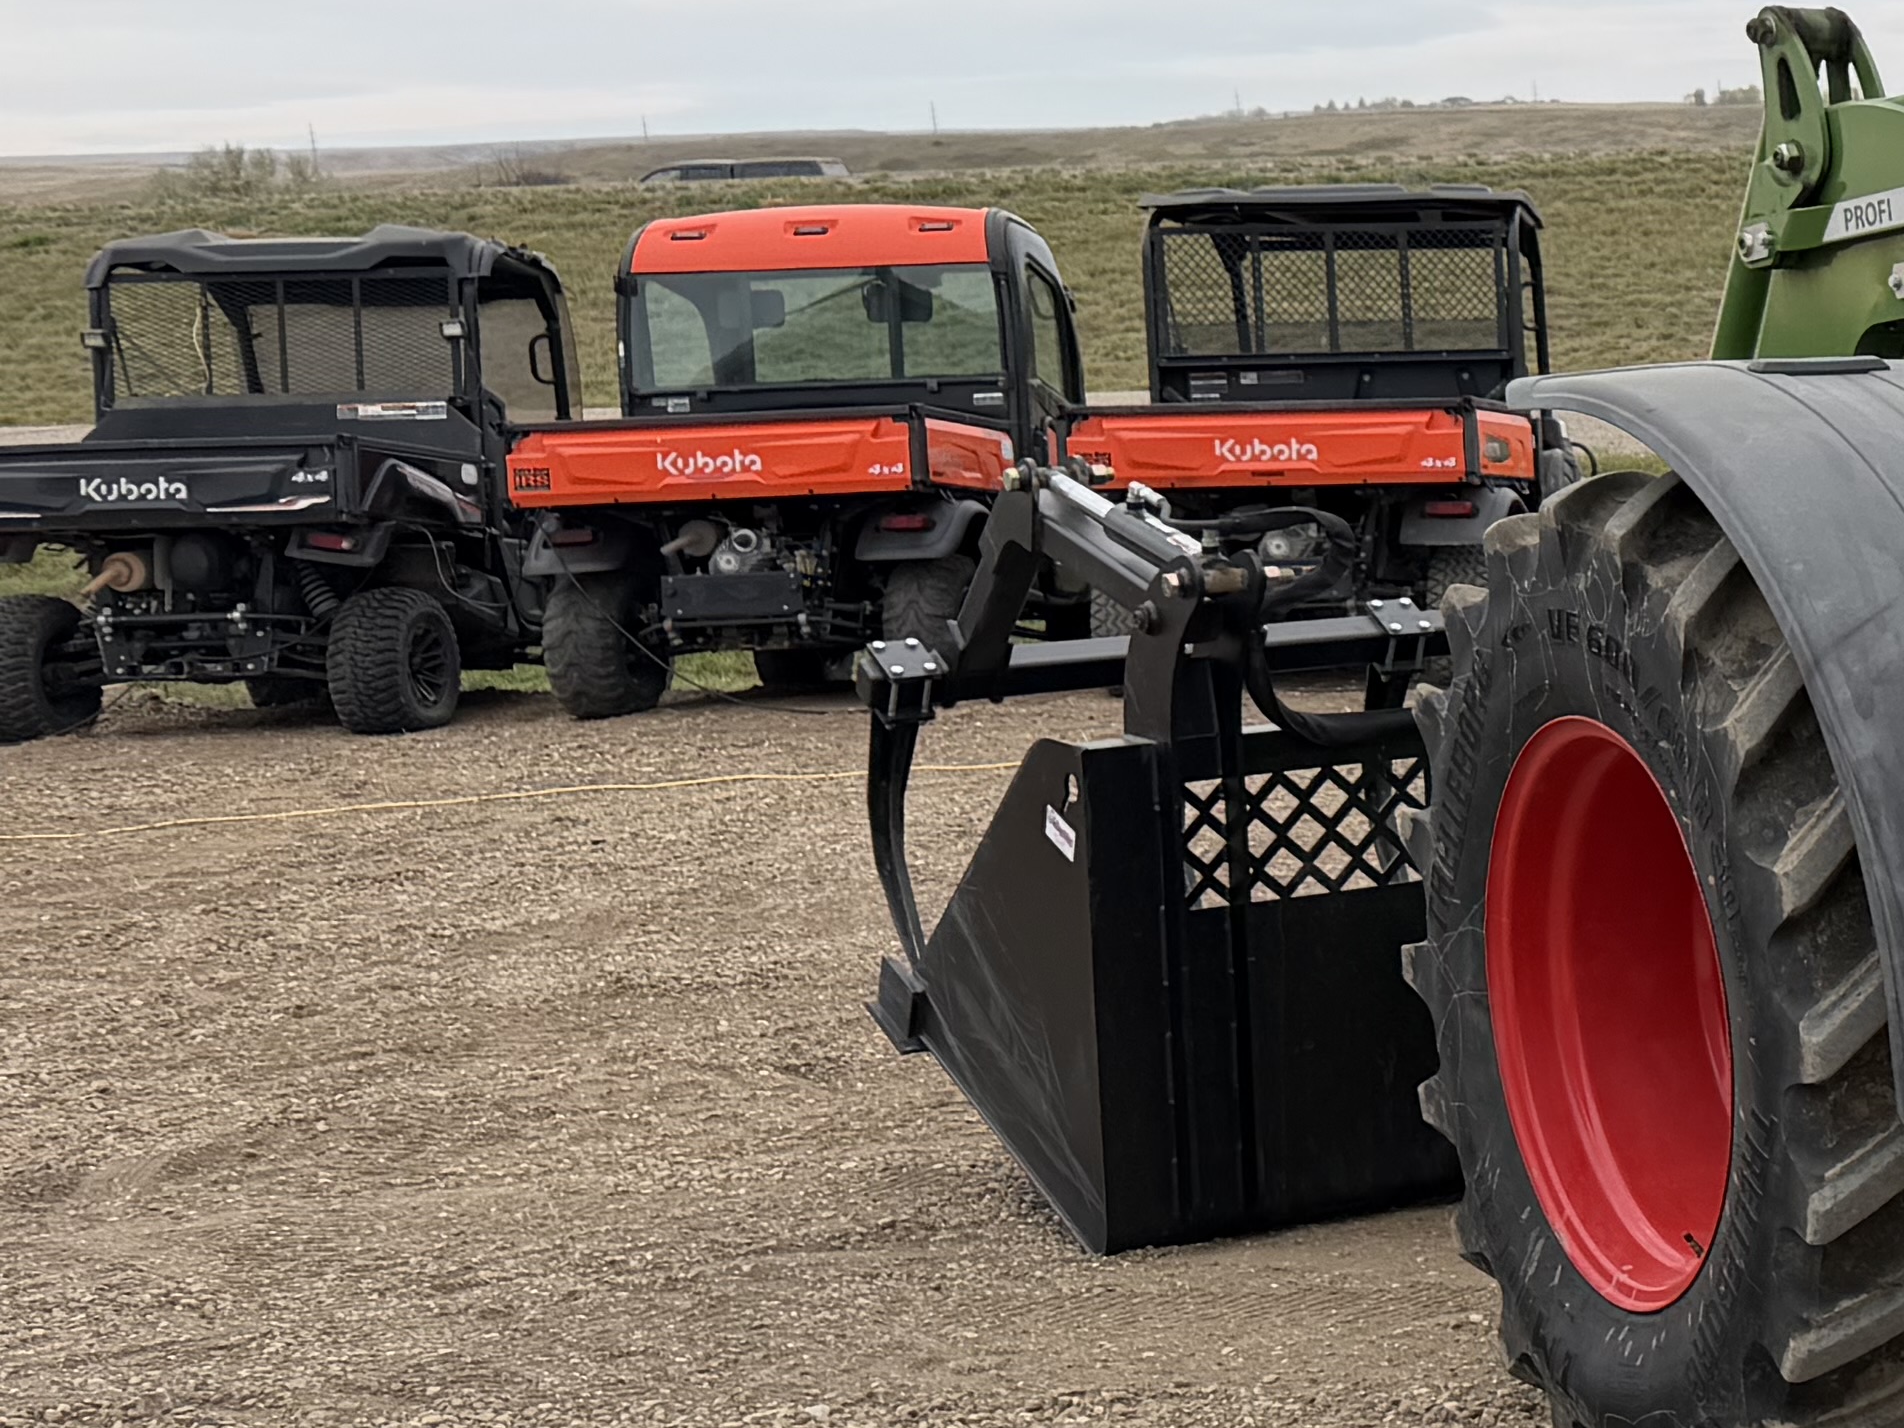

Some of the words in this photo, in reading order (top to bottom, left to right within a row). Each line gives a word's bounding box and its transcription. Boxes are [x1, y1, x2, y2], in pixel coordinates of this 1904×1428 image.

[1842, 197, 1893, 232] PROFI
[656, 449, 763, 475] Kubota
[1214, 438, 1319, 463] Kubota
[80, 476, 188, 502] Kubota
